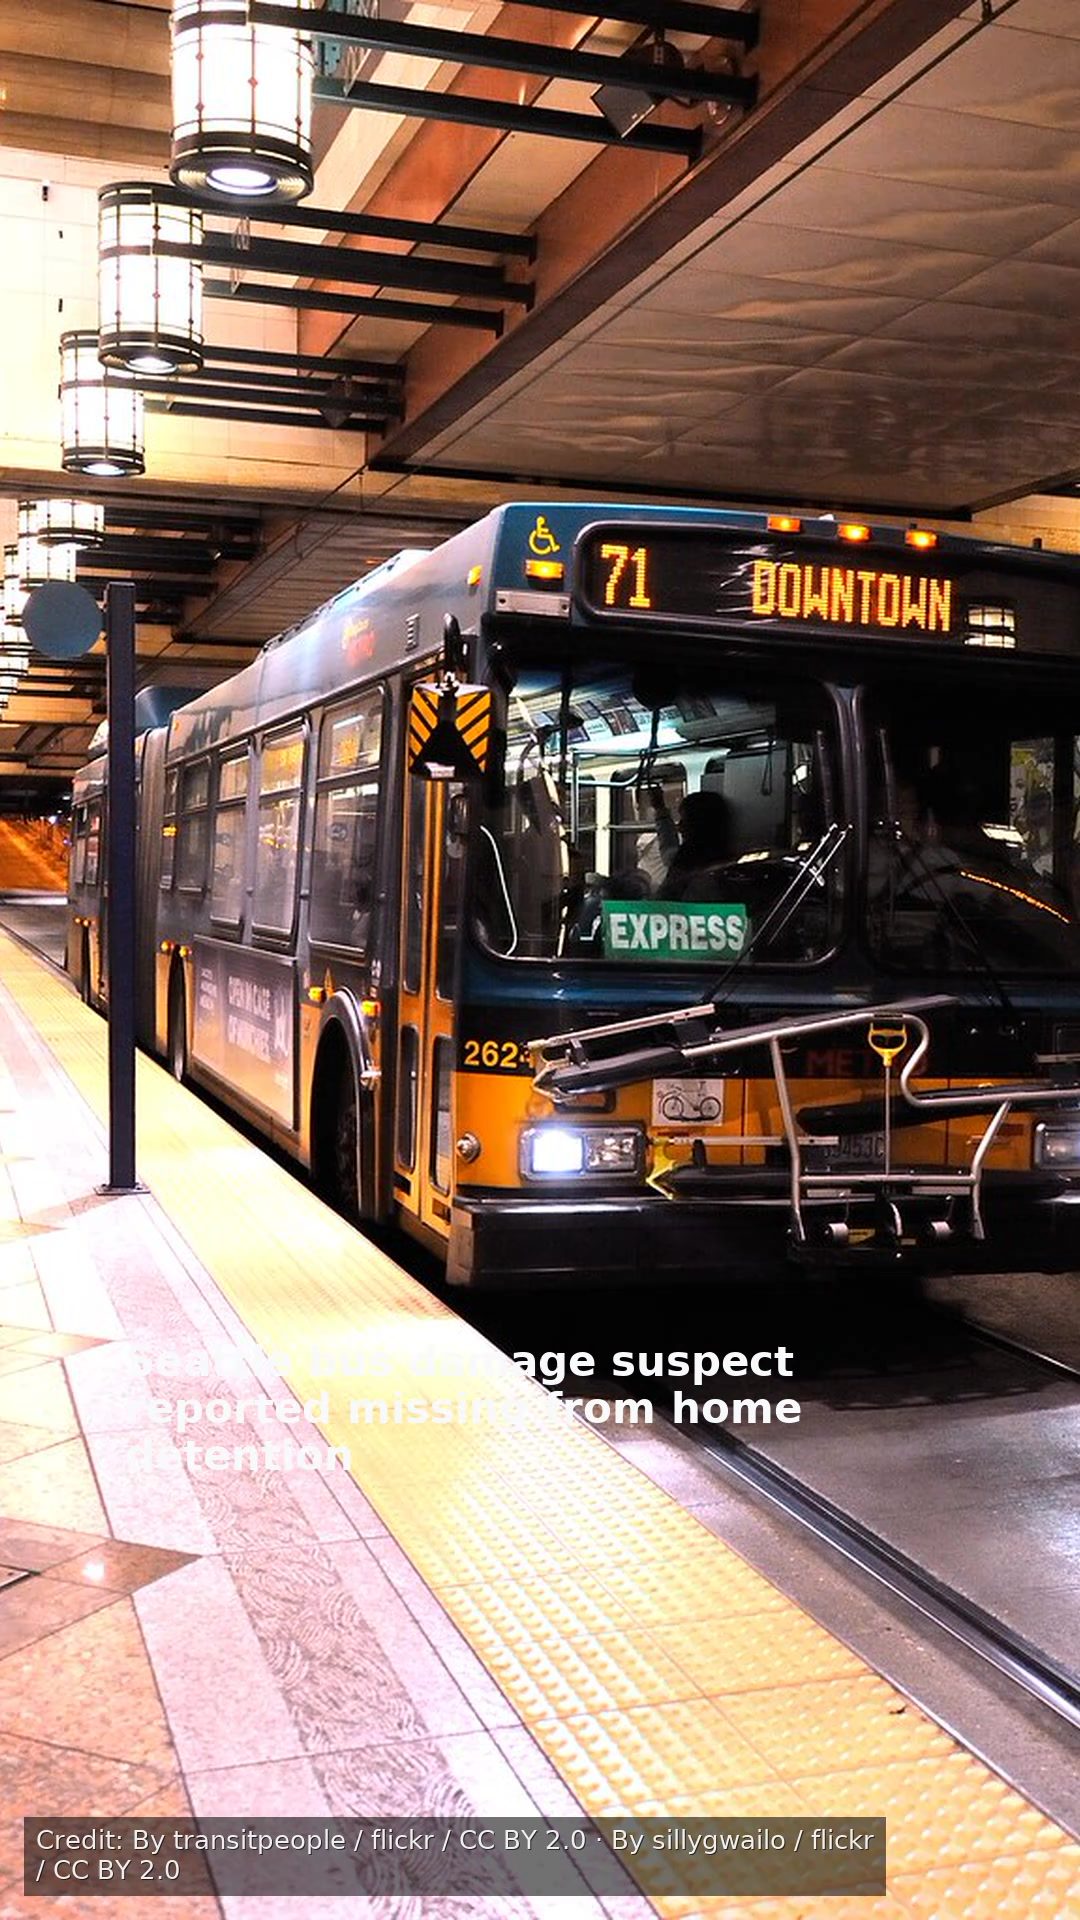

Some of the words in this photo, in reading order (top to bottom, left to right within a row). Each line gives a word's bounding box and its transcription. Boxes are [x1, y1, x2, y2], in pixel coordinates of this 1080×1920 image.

[601, 543, 650, 609] 71
[752, 559, 951, 631] DOWNTOWN
[609, 912, 745, 951] EXPRESS
